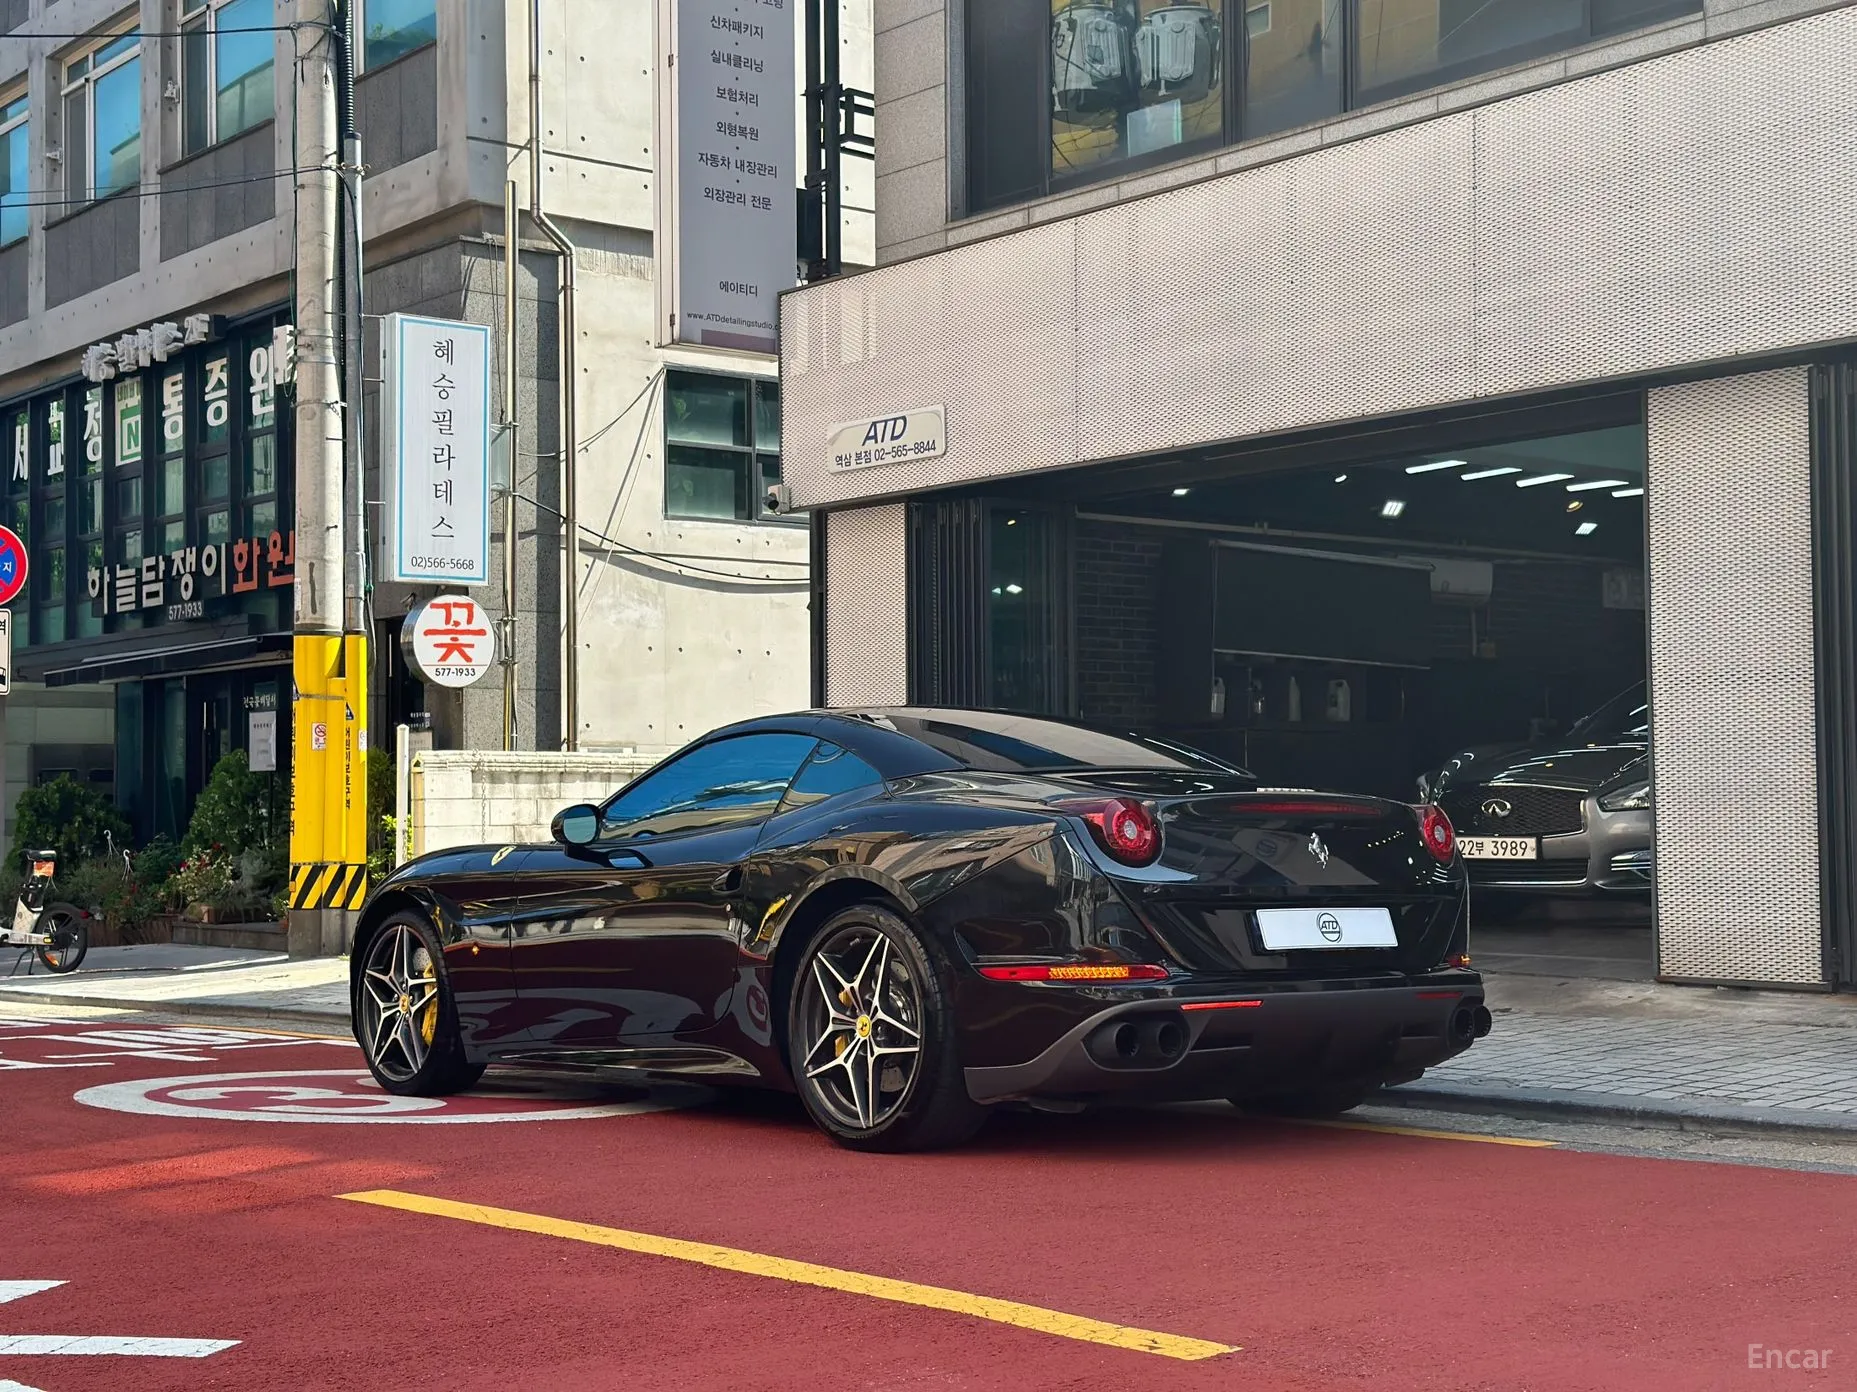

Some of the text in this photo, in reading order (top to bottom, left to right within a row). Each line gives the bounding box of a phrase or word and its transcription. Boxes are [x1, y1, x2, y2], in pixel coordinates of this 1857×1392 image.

[710, 15, 764, 39] 신차패키지
[710, 49, 764, 73] 실내클리닝
[716, 86, 759, 107] 보험처리
[716, 121, 759, 141] 외형복원
[698, 152, 778, 179] 자동차 내장관리
[703, 187, 772, 211] 외장관리 전문
[719, 281, 758, 297] 에이티디
[862, 415, 907, 446] ATD
[835, 439, 936, 468] 역삼 본점 02-565-8844
[411, 556, 474, 570] 02)566-5668
[168, 601, 203, 621] 577-1933
[423, 602, 487, 663] 꽃
[435, 668, 476, 677] 577-1933
[1460, 840, 1528, 857] 22부 3989
[1320, 920, 1338, 930] ATD
